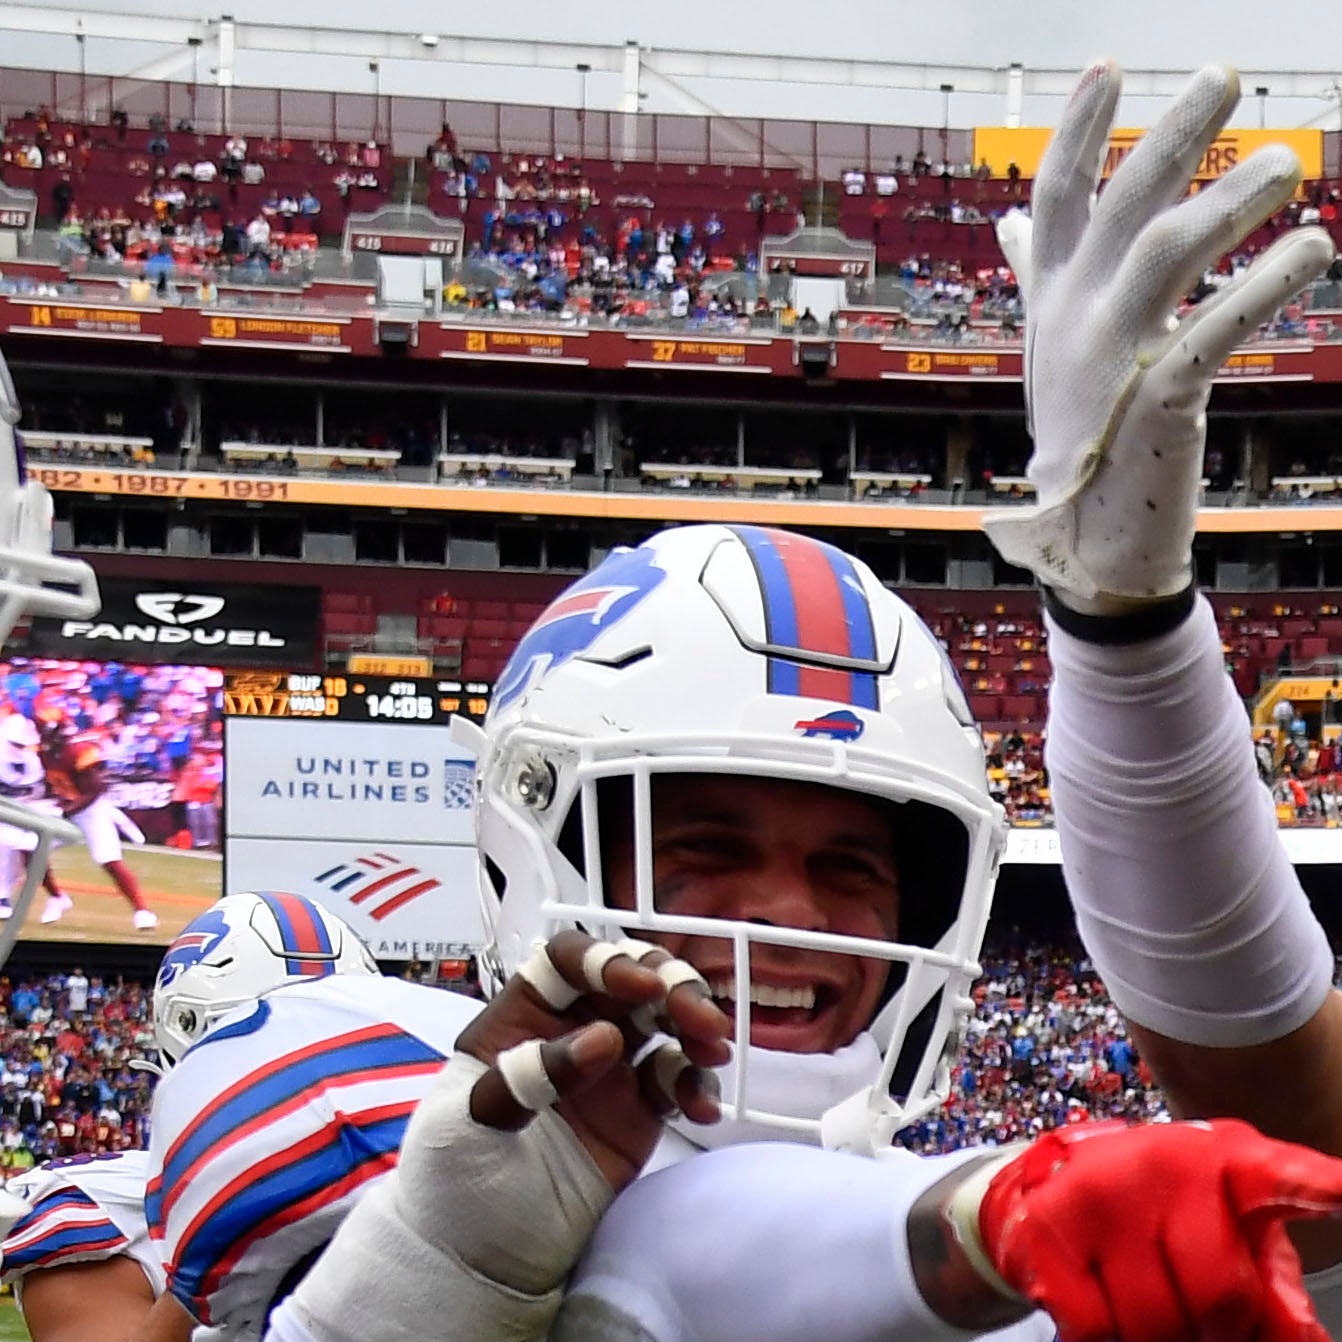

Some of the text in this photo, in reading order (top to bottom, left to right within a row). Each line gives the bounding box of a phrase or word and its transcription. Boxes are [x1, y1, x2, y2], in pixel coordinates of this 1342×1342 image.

[113, 474, 189, 494] 1987
[218, 479, 290, 500] 1991
[61, 621, 287, 647] FANDUEL
[288, 674, 322, 691] BUF
[296, 757, 431, 779] UNITED
[261, 780, 431, 804] AIRLINES
